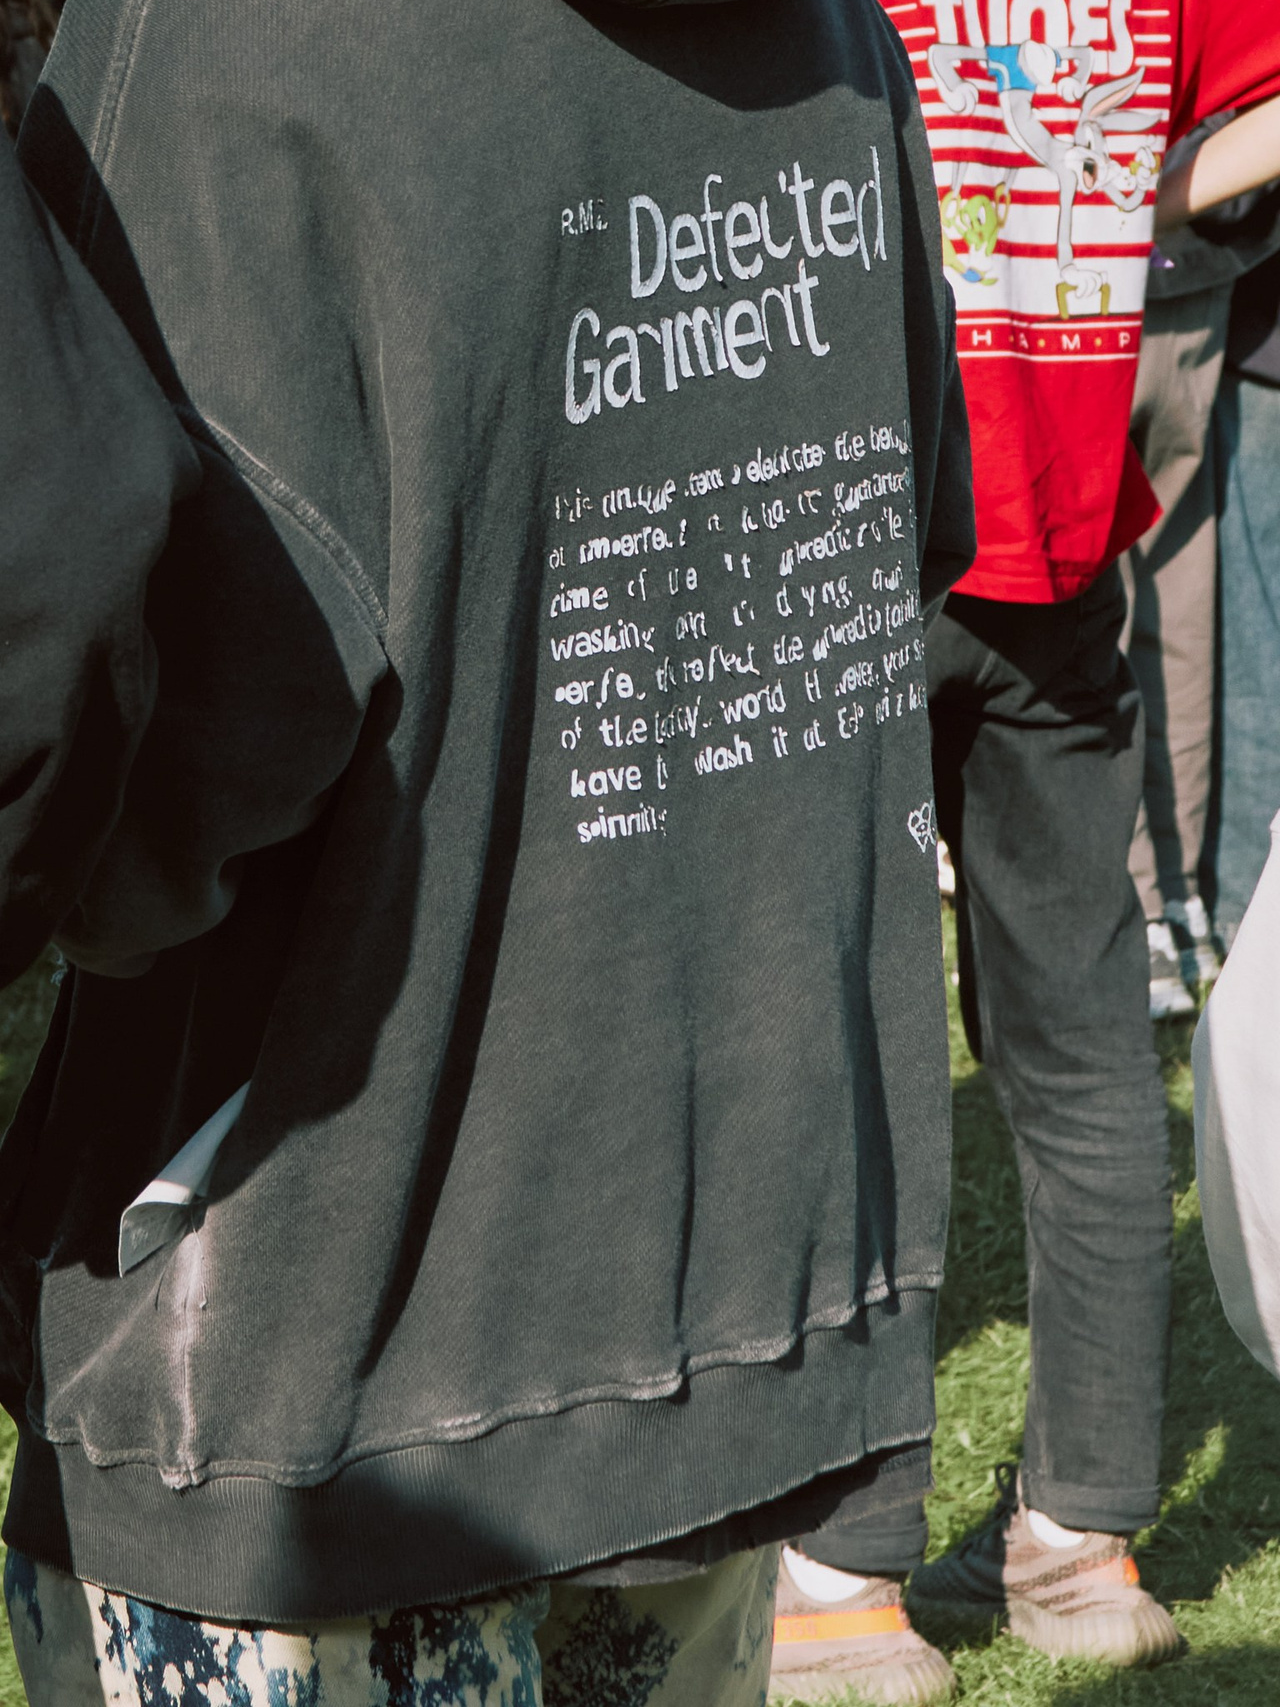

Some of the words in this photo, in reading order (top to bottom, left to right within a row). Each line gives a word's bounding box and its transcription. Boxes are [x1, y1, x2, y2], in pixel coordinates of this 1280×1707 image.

[628, 145, 887, 299] Defected
[565, 258, 831, 426] Garment
[771, 725, 789, 759] it
